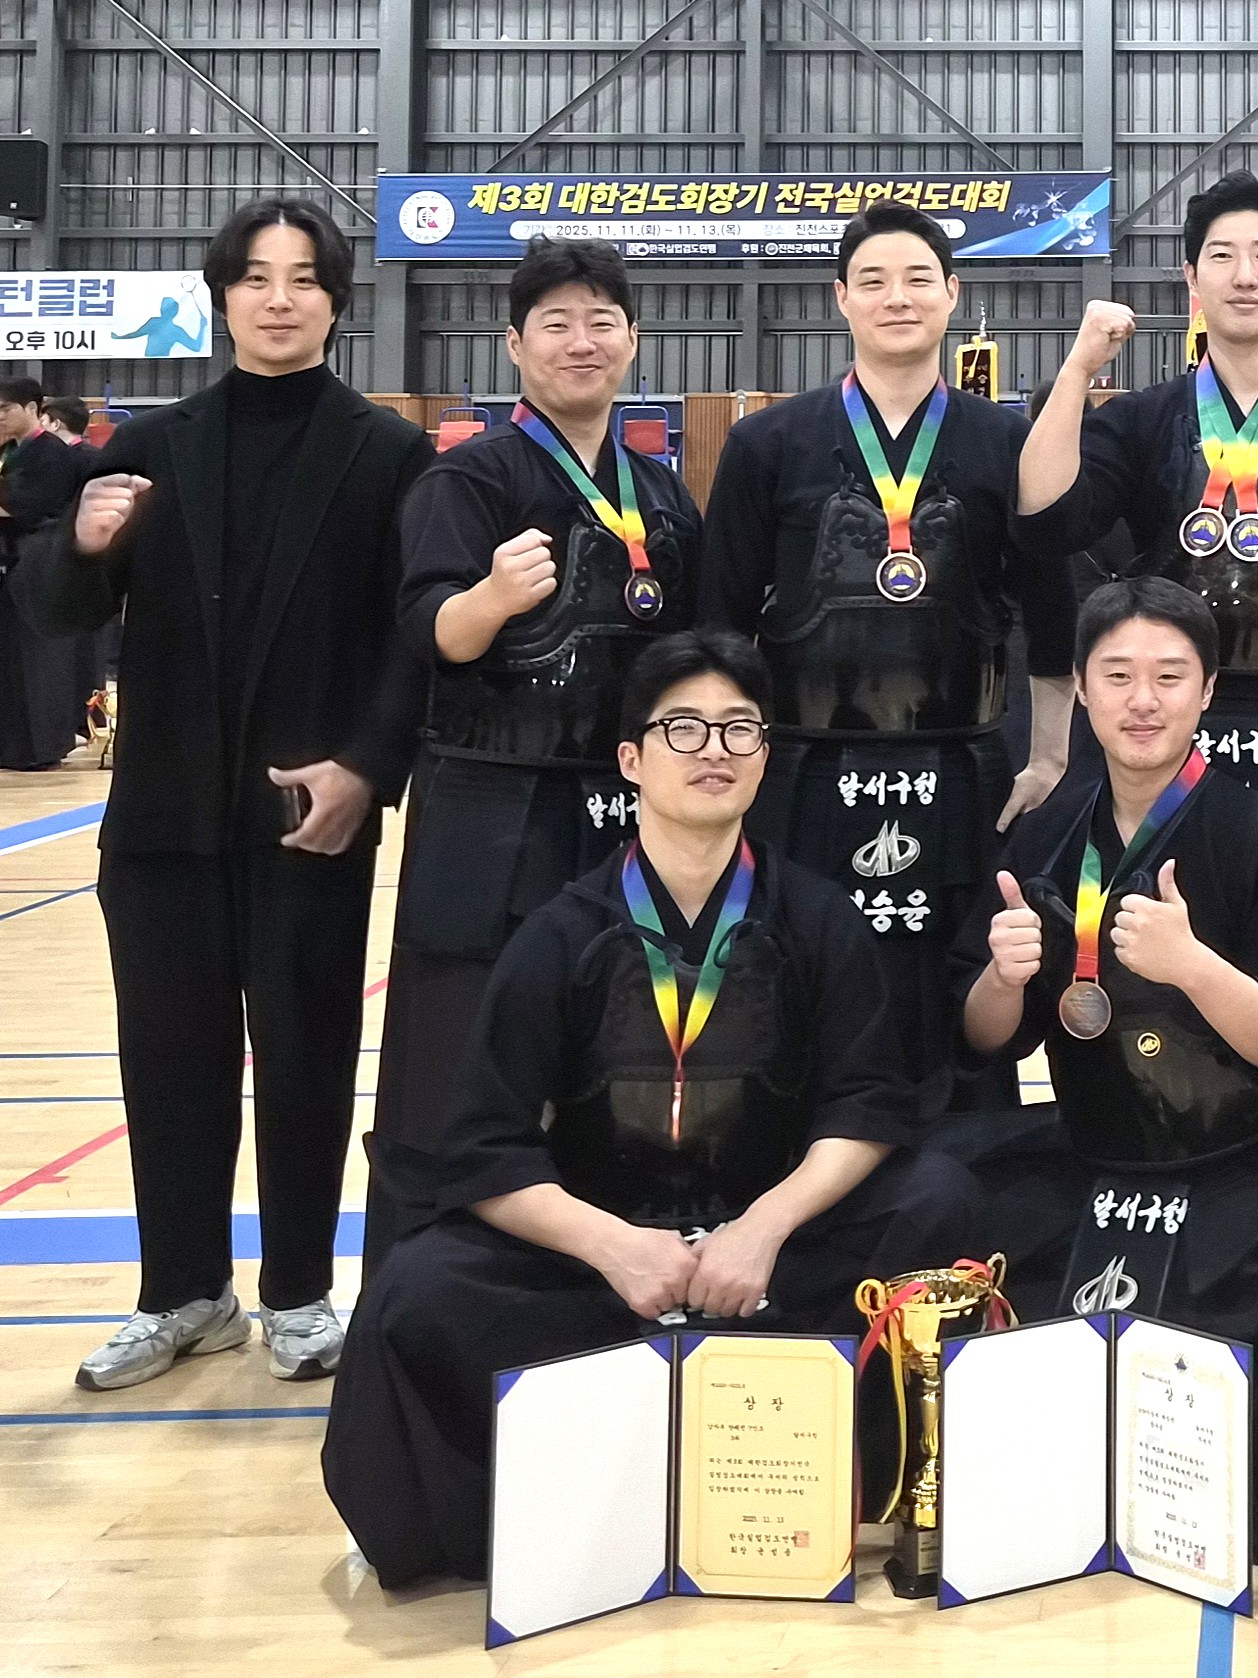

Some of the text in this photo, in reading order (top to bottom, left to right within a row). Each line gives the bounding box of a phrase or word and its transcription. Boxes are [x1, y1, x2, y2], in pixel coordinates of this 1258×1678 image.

[468, 181, 553, 215] 제3회
[558, 181, 769, 215] 대한검도회장기
[556, 224, 593, 237] 2025.
[6, 330, 96, 350] 오후 10시
[837, 771, 938, 807] 달서구청
[586, 792, 641, 829] 달서구
[1093, 1189, 1188, 1234] 달서구청
[744, 1395, 784, 1411] 상 장
